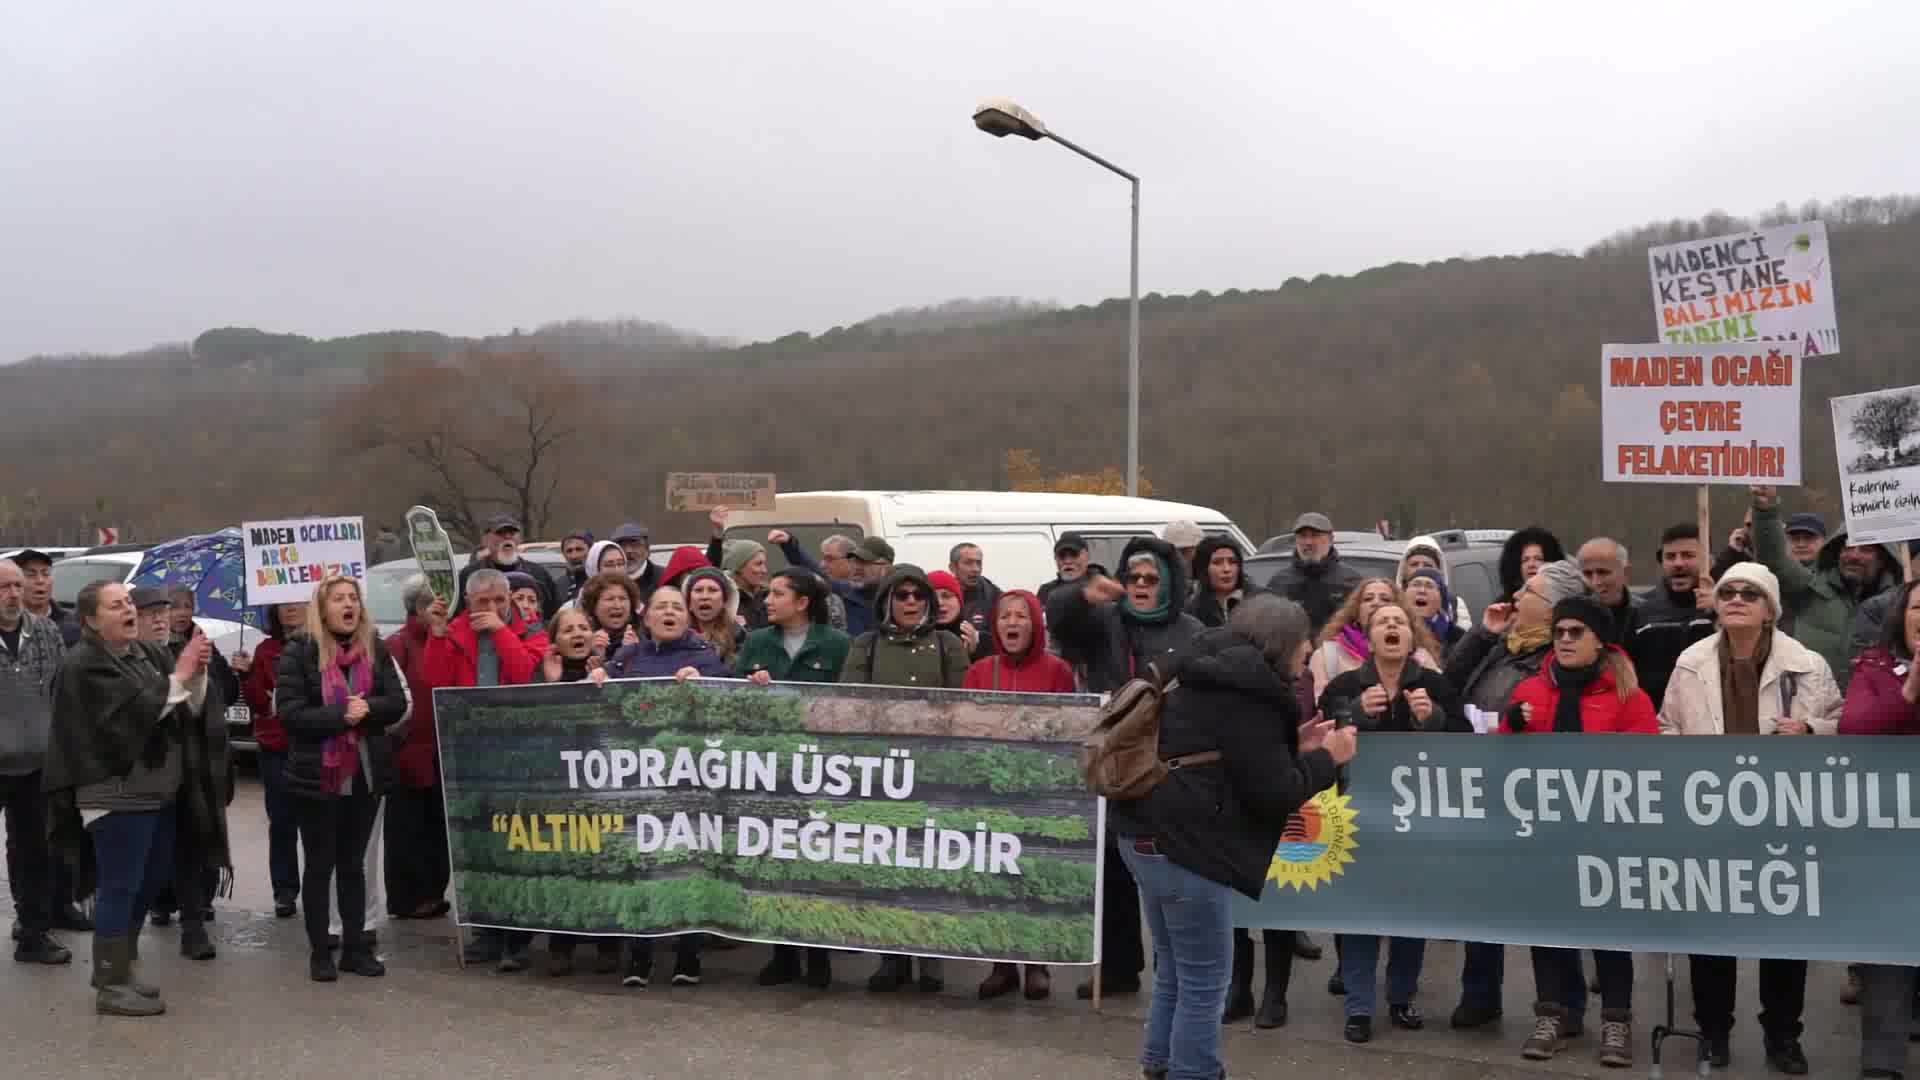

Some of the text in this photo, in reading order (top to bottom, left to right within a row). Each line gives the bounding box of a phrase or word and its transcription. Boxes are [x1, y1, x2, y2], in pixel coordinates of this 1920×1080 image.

[1654, 232, 1769, 278] MADENCİ
[1659, 259, 1788, 304] KESTANE
[1664, 280, 1814, 327] BALIMIZIN
[1610, 350, 1793, 387] MADEN OCAĞI
[1659, 401, 1742, 434] ÇEVRE
[1617, 440, 1785, 478] FELAKETİDİR!
[250, 522, 362, 547] MADEN OCAKLARI
[560, 739, 915, 800] TOPRAĞIN ÜSTÜ
[1391, 751, 1486, 832] ŞİLE
[1504, 767, 1664, 837] ÇEVRE
[636, 811, 723, 855] DAN
[737, 810, 1021, 875] DEĞERLİDİR
[1577, 843, 1821, 917] DERNEĞİ
